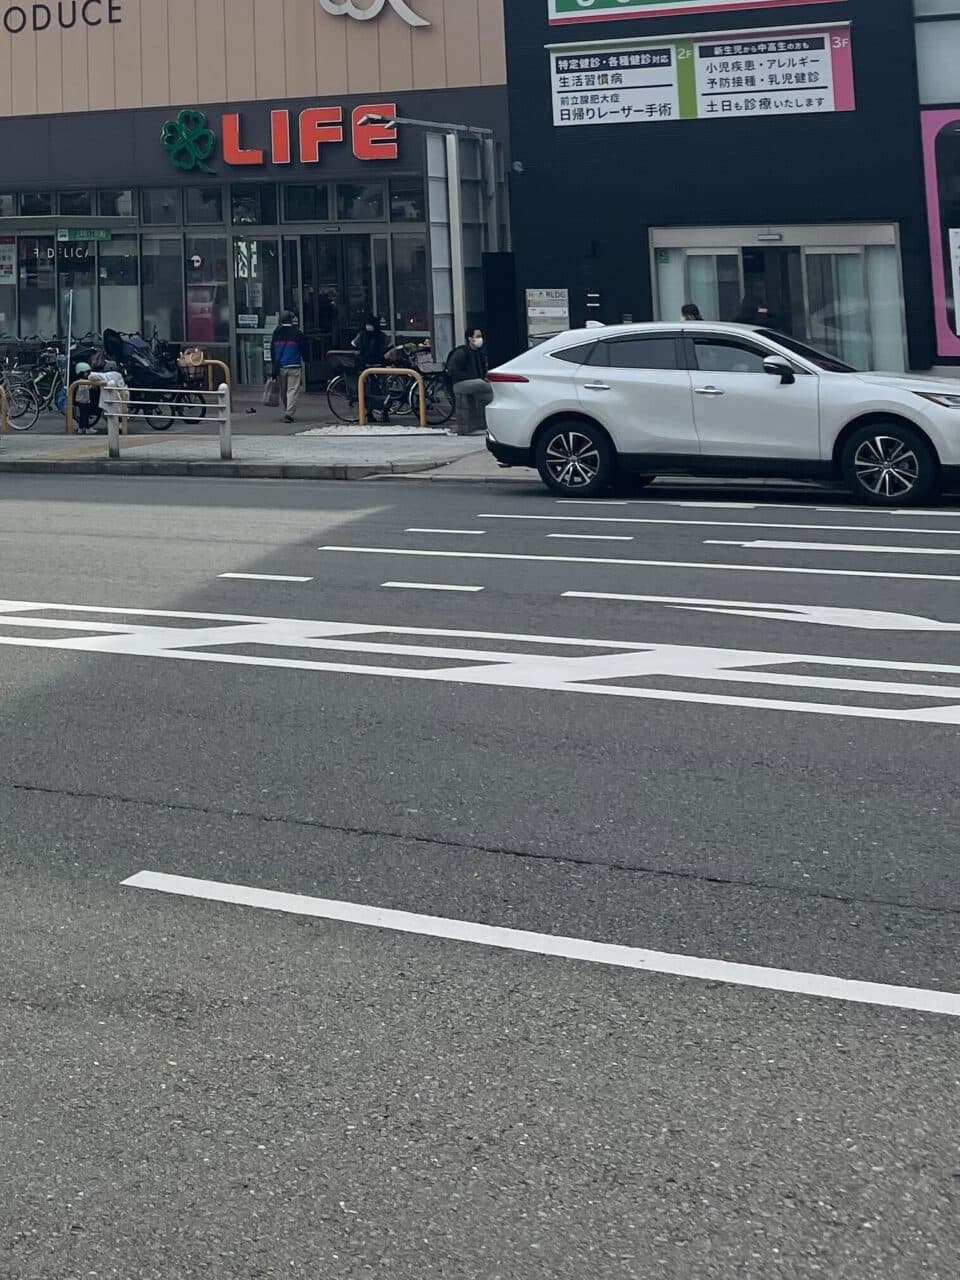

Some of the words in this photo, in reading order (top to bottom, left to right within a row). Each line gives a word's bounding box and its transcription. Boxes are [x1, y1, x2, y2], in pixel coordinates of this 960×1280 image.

[831, 37, 849, 49] 3F
[677, 48, 692, 60] 2F
[706, 56, 820, 73] 小児疾患・アレルギー
[559, 73, 623, 88] 生活習慣病
[707, 71, 819, 88] 予防接種・乳児健診
[560, 92, 621, 105] 前立腺肥大症
[706, 96, 825, 113] 土日も診療いたします
[561, 102, 672, 122] 日帰りレーザー手術
[221, 103, 398, 165] LIFE
